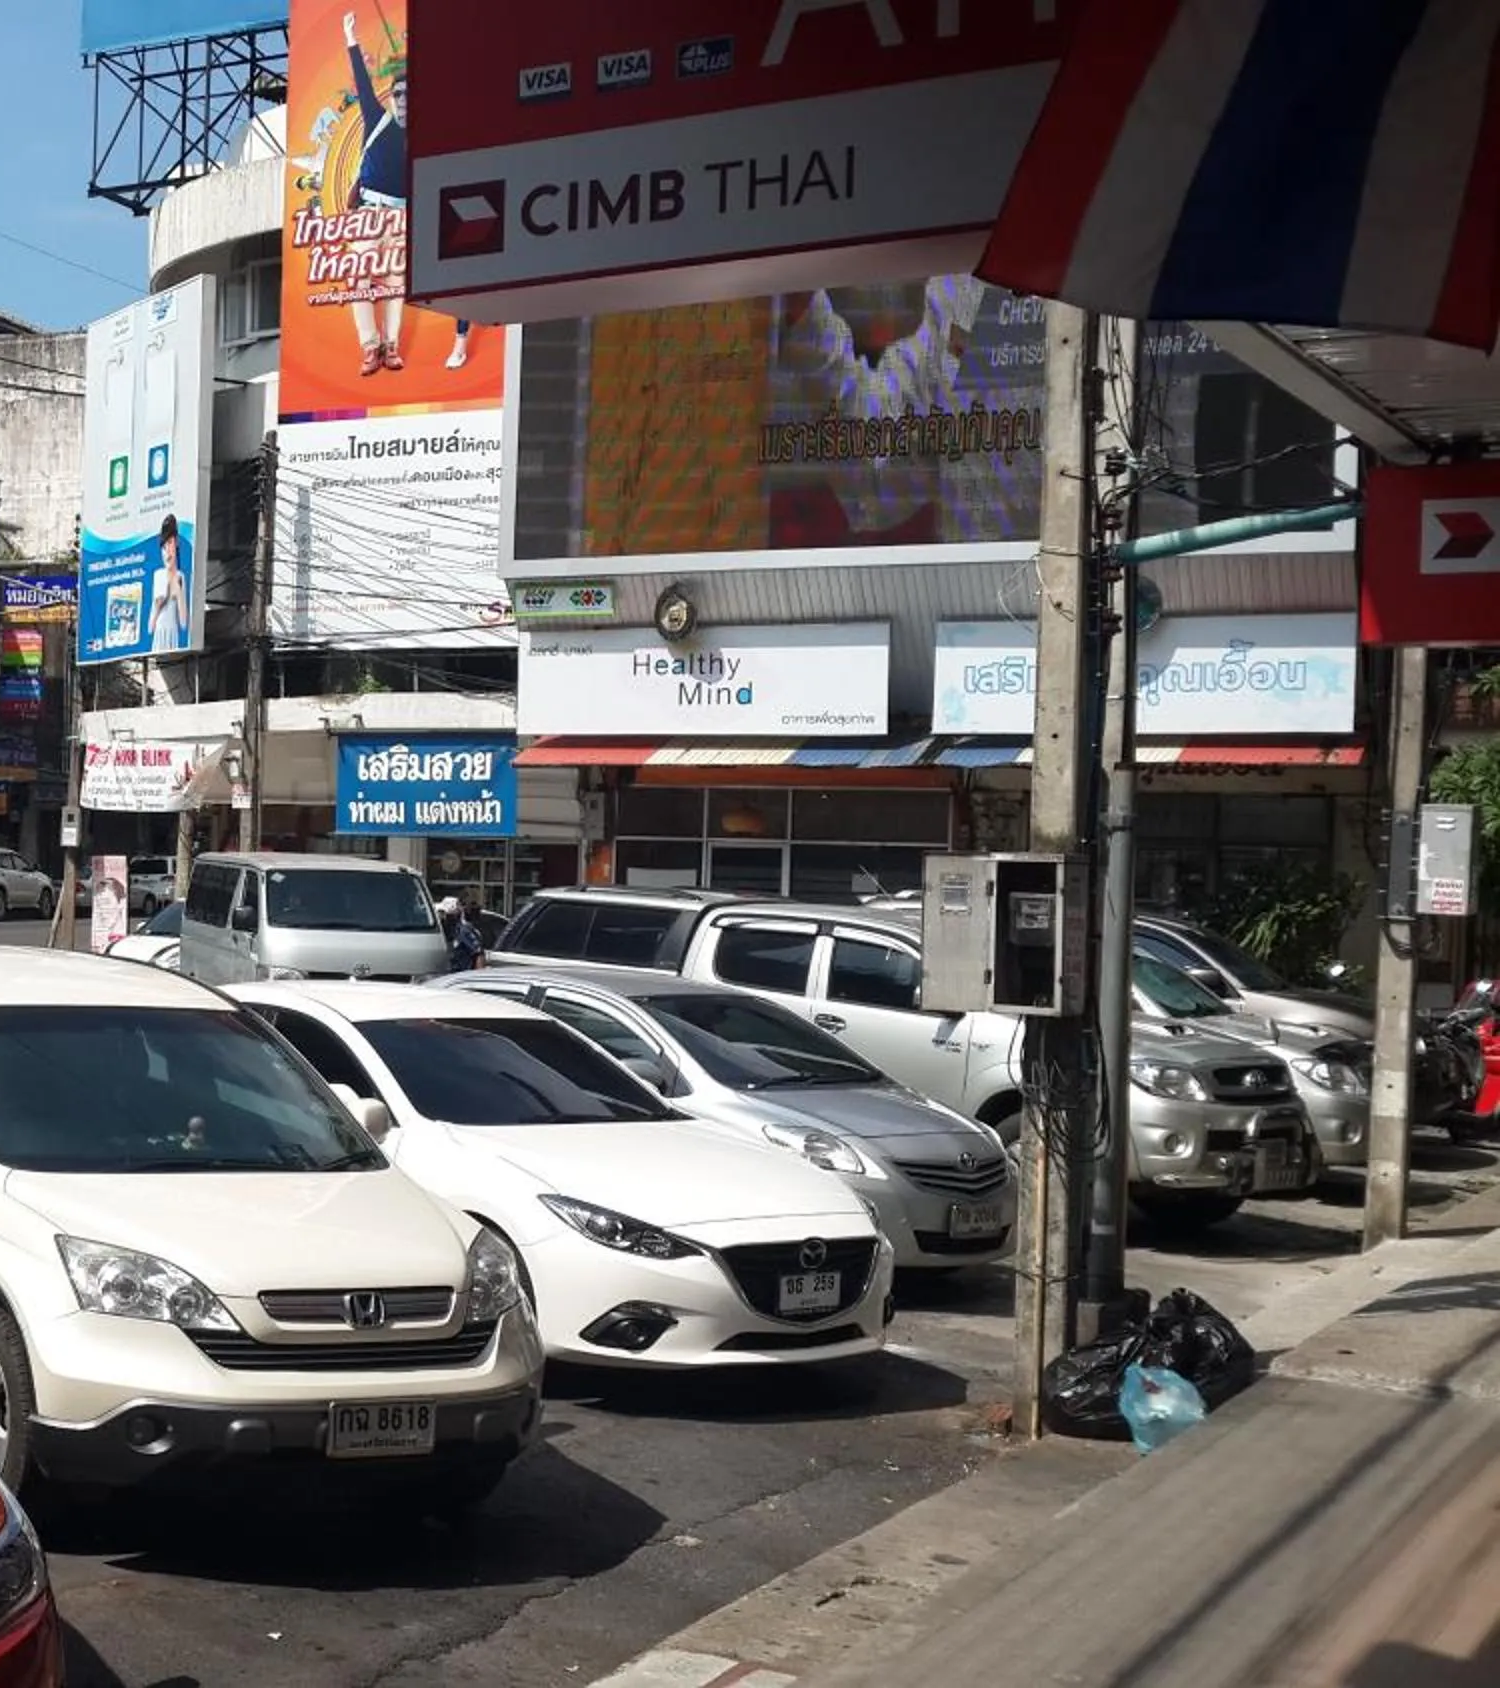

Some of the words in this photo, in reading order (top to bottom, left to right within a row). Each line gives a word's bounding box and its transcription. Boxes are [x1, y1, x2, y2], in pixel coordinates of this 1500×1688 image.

[602, 53, 649, 79] VISA
[692, 49, 732, 72] PLUS
[524, 65, 569, 91] VISA
[520, 168, 686, 237] CIMB
[703, 145, 856, 214] THAI
[632, 651, 742, 680] Healthy
[677, 681, 754, 706] Mind
[357, 743, 493, 782] เสริมสวย
[348, 791, 405, 825] ทำผม
[414, 788, 502, 825] แต่งหน้า
[377, 1404, 429, 1432] 8618
